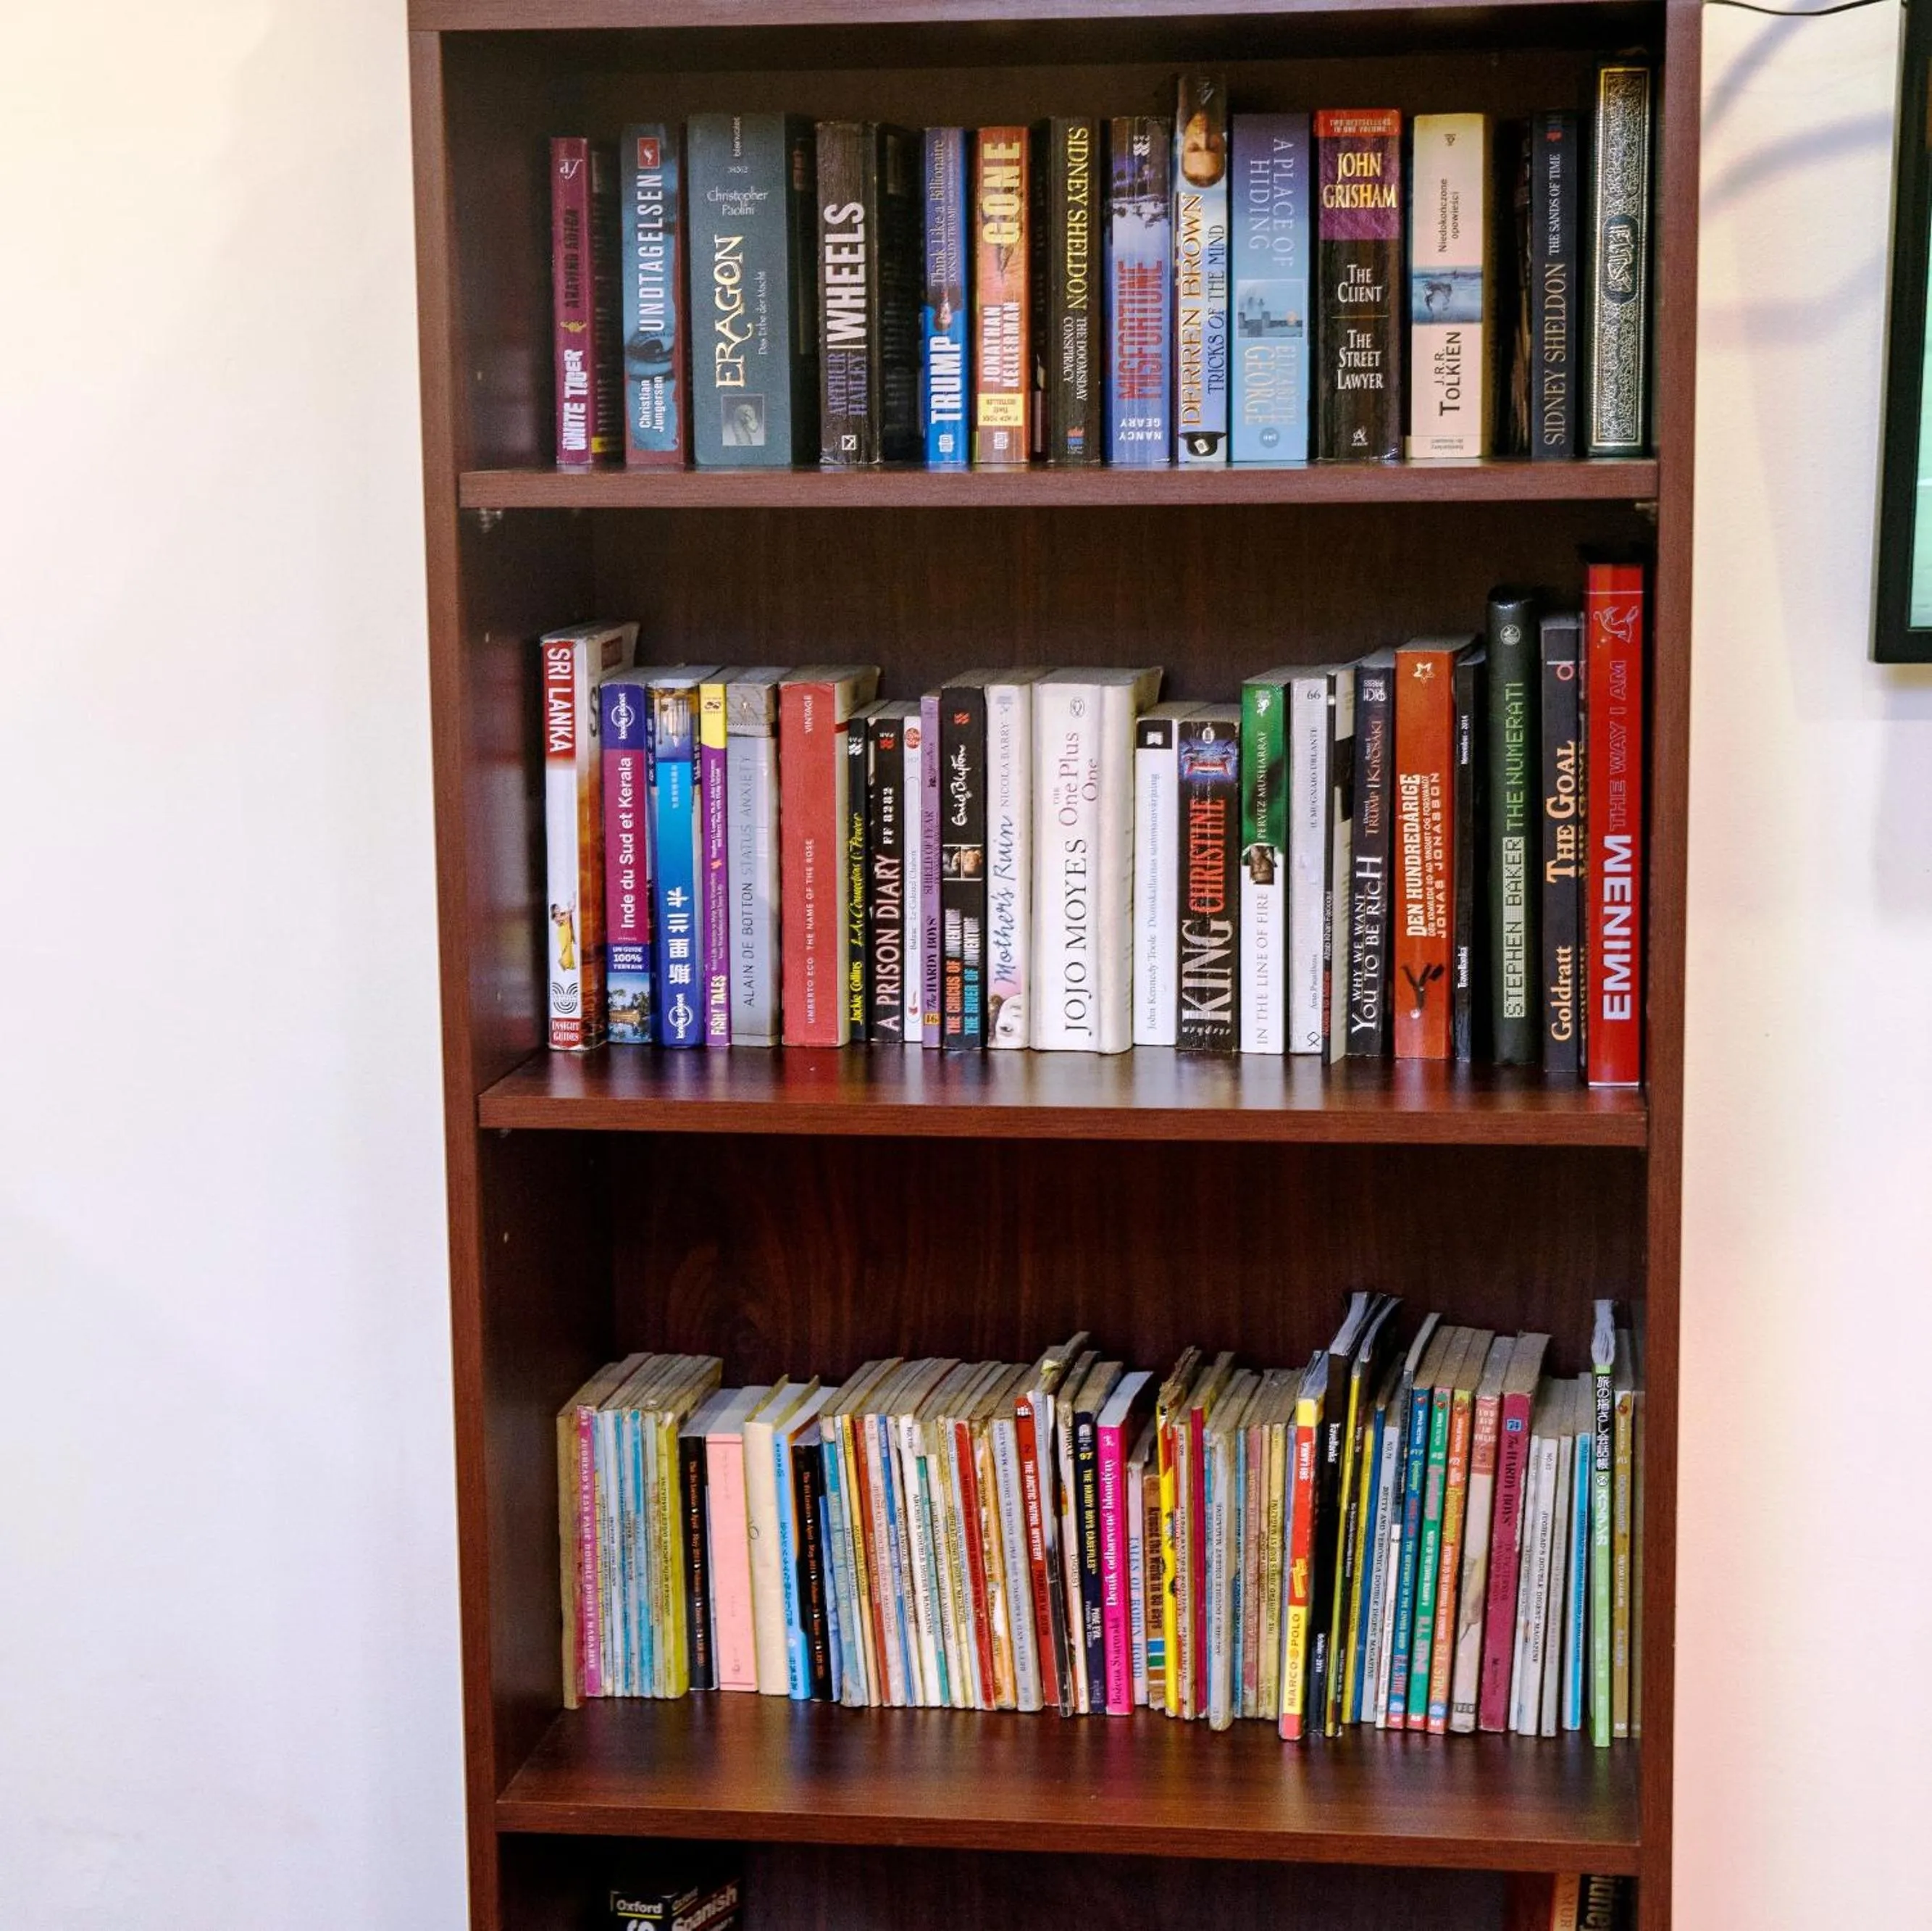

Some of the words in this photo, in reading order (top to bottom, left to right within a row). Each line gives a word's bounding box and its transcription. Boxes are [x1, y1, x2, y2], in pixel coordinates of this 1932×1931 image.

[1274, 138, 1294, 153] A
[1337, 153, 1381, 178] JOHN
[929, 140, 945, 201] Billionaire
[1066, 127, 1087, 207] SIDNEY
[1548, 154, 1560, 180] TIME
[982, 141, 1021, 243] GONE
[1249, 159, 1269, 250] HIDING
[1273, 159, 1294, 232] PLACE
[1323, 184, 1397, 209] GRISHAM
[1549, 182, 1560, 196] OF
[934, 206, 945, 216] a
[1549, 199, 1560, 232] SANDS
[637, 174, 664, 332] UNDTAGELSEN
[931, 221, 945, 244] Like
[1180, 193, 1203, 299] BROWN
[1208, 225, 1224, 265] MIND
[1271, 236, 1293, 267] OF
[1548, 234, 1560, 255] THE
[823, 201, 867, 342] WHEELS
[931, 249, 946, 286] Think
[1066, 210, 1087, 310] SHELDON
[1346, 264, 1372, 283] THE
[1208, 270, 1224, 302] THE
[1337, 282, 1382, 303] CLIENT
[714, 233, 753, 388] ERAGON
[1117, 261, 1163, 399] MISFORTUNE
[1208, 307, 1224, 328] OF
[1544, 263, 1565, 362] SHELDON
[984, 306, 1000, 382] JONATHAN
[1002, 302, 1019, 387] KELLERMAN
[1338, 347, 1381, 368] STREET
[1346, 330, 1371, 348] THE
[564, 349, 588, 399] TIGER
[930, 335, 963, 424] TRUMP
[1181, 309, 1203, 426] DERREN
[1208, 332, 1225, 394] TRICKS
[1337, 370, 1384, 389] LAWYER
[1434, 349, 1445, 386] J.R.R.
[1439, 331, 1462, 416] TOLKIEN
[639, 380, 651, 429] Christian
[653, 376, 665, 433] Jungersen
[1244, 345, 1275, 425] GEORGE
[563, 403, 587, 451] WHITE
[1544, 370, 1565, 445] SIDNEY
[547, 648, 572, 680] SRI
[1609, 662, 1626, 702] AM
[548, 688, 573, 752] LANKA
[1505, 683, 1523, 785] NUMERATI
[951, 746, 967, 793] Blyton
[1058, 733, 1079, 779] Plus
[1256, 732, 1267, 797] MUSHARRAF
[1609, 723, 1626, 775] WAY
[619, 756, 632, 807] Kerala
[1082, 759, 1097, 802] One
[1546, 741, 1577, 819] GOAL
[620, 812, 632, 829] et
[952, 793, 971, 825] Enid
[1058, 783, 1079, 827] One
[1257, 801, 1266, 839] PERVEZ
[1431, 772, 1442, 870] JONASSON
[1507, 791, 1524, 830] THE
[1609, 780, 1627, 833] THE
[619, 834, 633, 864] Sud
[805, 840, 814, 864] ROSE
[992, 815, 1016, 881] Ruin
[1189, 799, 1226, 913] CHRISTINE
[1398, 774, 1423, 900] HUNDREDÅRIGE
[1547, 825, 1576, 883] THE
[621, 870, 632, 888] du
[874, 854, 900, 919] DIARY
[1356, 856, 1383, 914] RICH
[1505, 838, 1522, 906] BAKER
[621, 894, 633, 928] Inde
[741, 883, 753, 935] BOTTON
[806, 888, 813, 900] OF
[1063, 840, 1087, 951] MOYES
[1256, 894, 1268, 924] FIRE
[1355, 893, 1363, 935] WANT
[1435, 880, 1446, 938] JONAS
[945, 909, 961, 958] ADVENTURE
[992, 888, 1016, 985] Mother's
[1256, 930, 1268, 948] OF
[1365, 925, 1379, 946] BE
[1405, 904, 1426, 936] DEN
[741, 941, 754, 959] DE
[963, 917, 979, 967] ADVENTURE
[1353, 942, 1363, 963] WE
[875, 924, 900, 1006] PRISON
[946, 961, 960, 974] OF
[964, 969, 978, 981] OF
[1182, 919, 1232, 1025] KING
[1256, 954, 1268, 986] LINE
[1353, 970, 1363, 1001] WHY
[1365, 954, 1378, 980] TO
[1505, 921, 1523, 1017] STEPHEN
[742, 966, 755, 1007] ALAIN
[946, 976, 961, 1013] CIRCUS
[965, 984, 979, 1014] RIVER
[1063, 962, 1092, 1036] JOJO
[1256, 994, 1268, 1021] THE
[1551, 946, 1573, 1041] Goldratt
[877, 1014, 900, 1032] A
[947, 1017, 961, 1035] THE
[965, 1017, 979, 1036] THE
[1352, 990, 1377, 1033] YOU
[1256, 1027, 1268, 1045] IN
[1024, 1460, 1034, 1474] THE
[1299, 1468, 1308, 1481] SRI
[1300, 1443, 1310, 1467] LANKA
[1291, 1614, 1300, 1646] POLO
[1287, 1661, 1297, 1707] MARCO
[616, 1899, 663, 1914] Oxford
